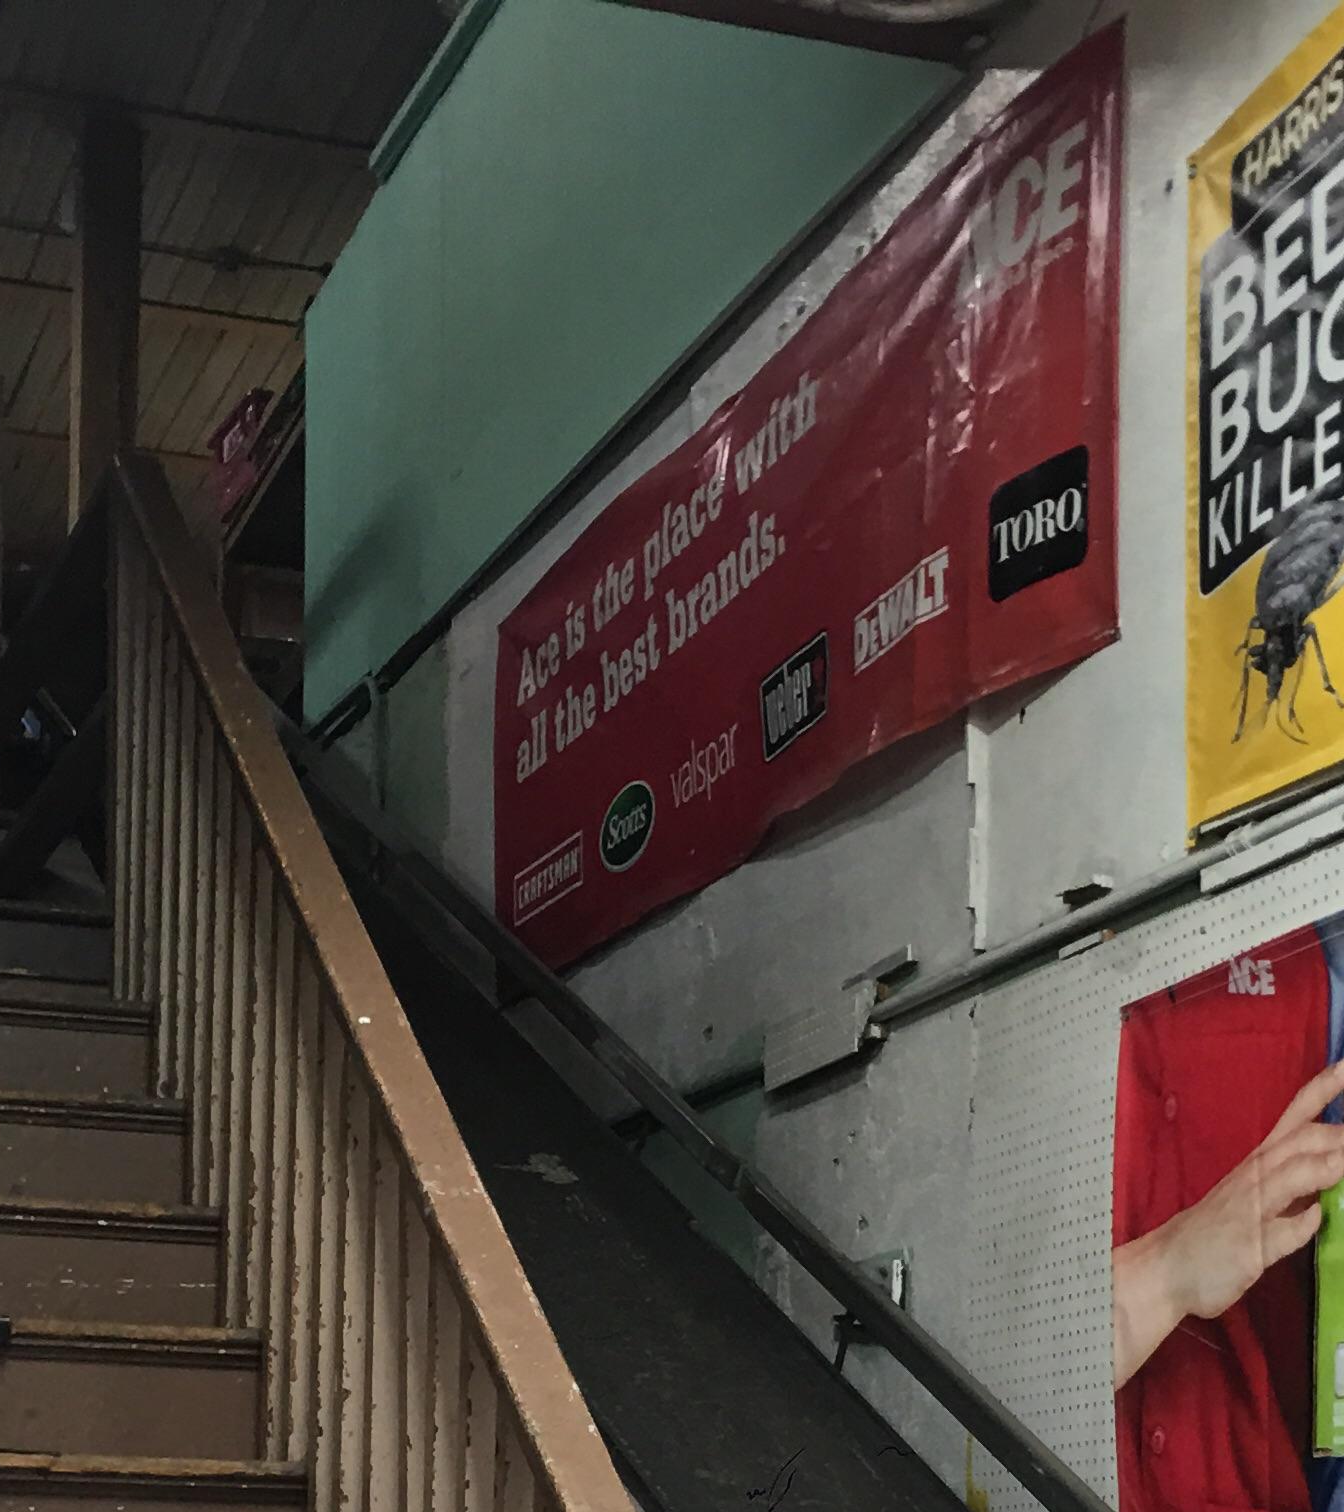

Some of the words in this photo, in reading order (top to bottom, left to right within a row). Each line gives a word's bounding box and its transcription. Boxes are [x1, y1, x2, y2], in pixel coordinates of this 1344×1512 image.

[1242, 58, 1344, 196] HARRIS
[516, 632, 561, 707] Ace
[565, 601, 586, 661] is
[593, 558, 634, 632] the
[643, 472, 724, 601] place
[735, 371, 821, 495] with
[993, 487, 1083, 563] TORO
[516, 709, 548, 783] all
[555, 685, 596, 753] the
[600, 613, 661, 712] best
[667, 510, 786, 655] brands.
[670, 722, 739, 808] valspar
[606, 801, 648, 850] Scotts
[518, 846, 579, 909] CRAFTSMAN
